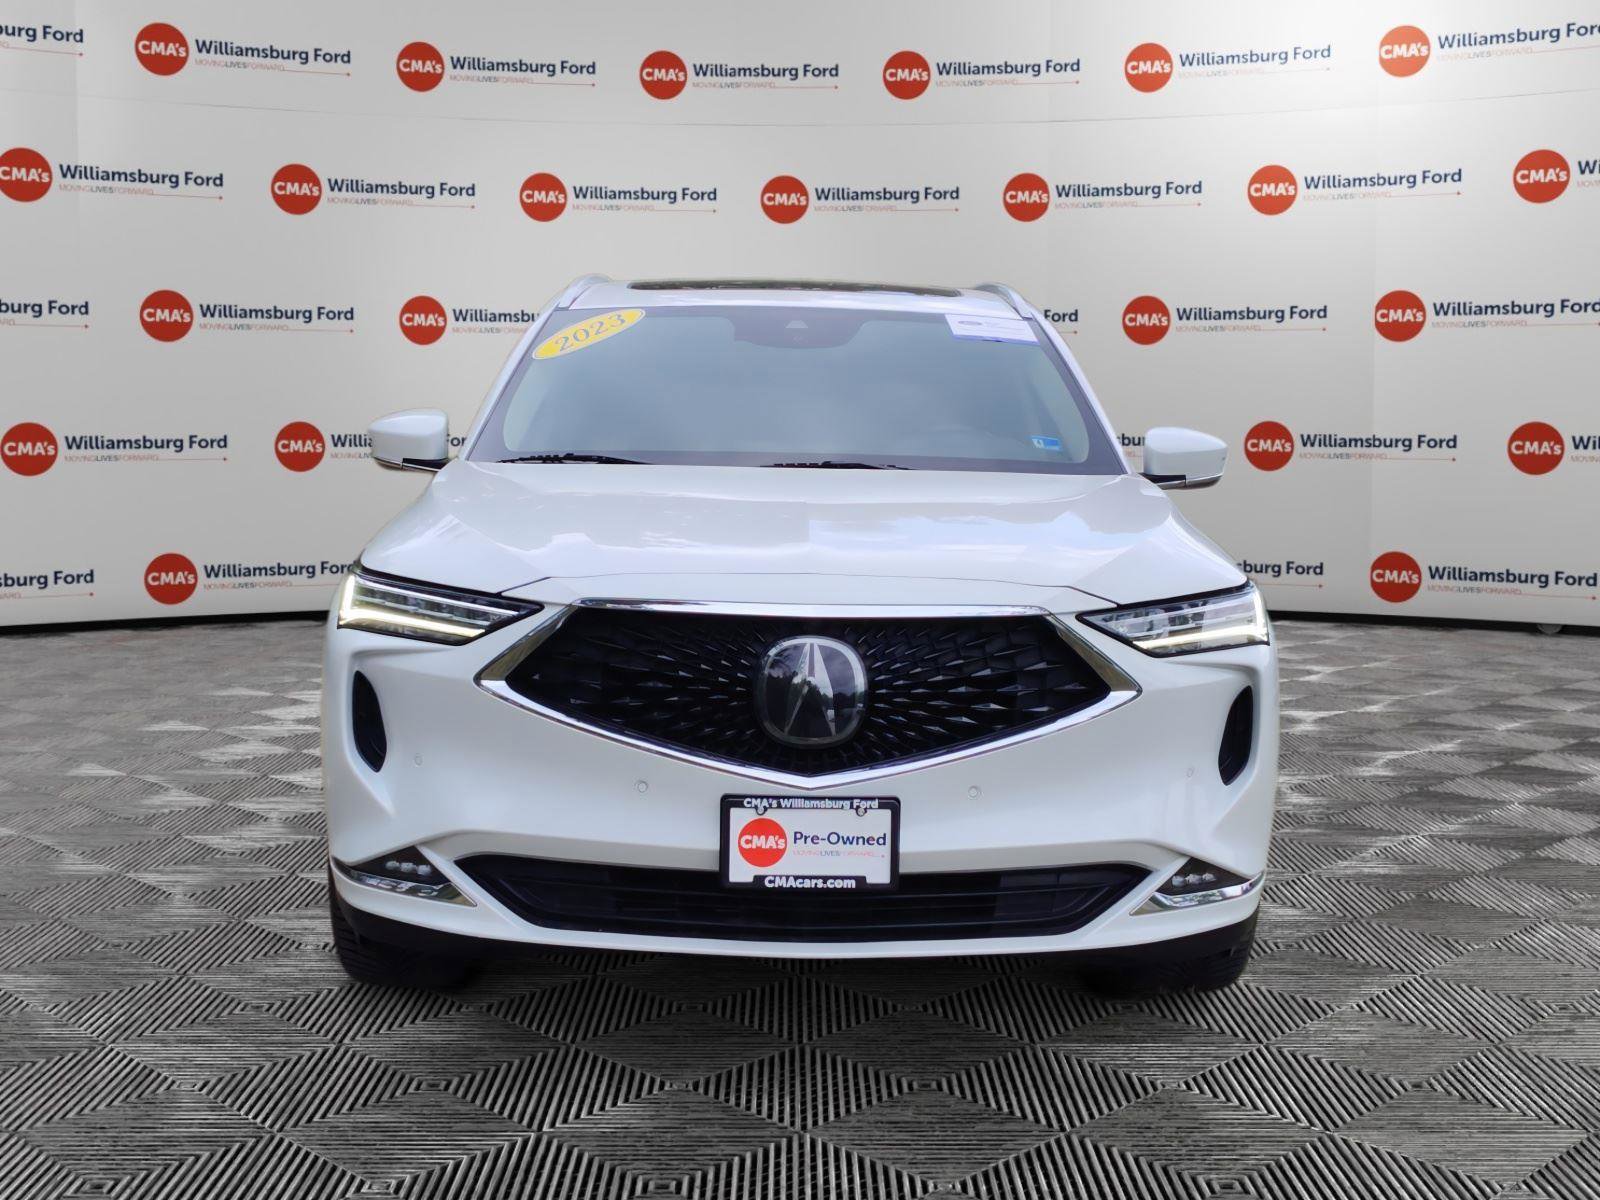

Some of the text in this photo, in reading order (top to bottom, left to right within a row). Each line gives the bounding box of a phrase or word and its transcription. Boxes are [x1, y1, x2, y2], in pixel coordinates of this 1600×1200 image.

[43, 25, 83, 43] Ford
[1380, 42, 1428, 59] CMA's
[1438, 28, 1560, 49] Williamsburg
[138, 39, 351, 65] CMA's Williamsburg Ford
[1127, 60, 1171, 74] CMA's
[1179, 50, 1288, 67] Williamsburg
[1293, 44, 1331, 60] Ford
[399, 56, 595, 77] CMA's Williamsburg Ford
[642, 64, 838, 82] CMA's Williamsburg Ford
[885, 59, 1080, 82] CMA's Williamsburg Ford
[0, 164, 223, 189] CMA's Williamsburg Ford
[1250, 168, 1462, 197] CMA's Williamsburg Ford
[1516, 168, 1567, 184] CMA's
[274, 178, 476, 199] CMA's Williamsburg Ford
[522, 186, 717, 204] CMA's Williamsburg Ford
[763, 187, 960, 206] CMA's Williamsburg Ford
[1005, 181, 1202, 203] CMA's Williamsburg Ford
[48, 300, 89, 315] Ford
[143, 304, 354, 324] CMA's Williamsburg Ford
[1125, 305, 1327, 326] CMA's Williamsburg Ford
[1377, 308, 1423, 323] CMA's
[1433, 300, 1555, 318] Williamsburg
[402, 312, 445, 327] CMA's
[554, 313, 626, 351] 2023
[3, 435, 228, 456] CMA's Williamsburg Ford
[278, 440, 322, 454] CMA's
[1247, 434, 1458, 453] CMA's Williamsburg Ford
[1511, 441, 1561, 456] CMA's
[54, 569, 95, 585] Ford
[147, 571, 195, 586] CMA's
[204, 562, 316, 579] Williamsburg
[1286, 561, 1324, 576] Ford
[1373, 565, 1598, 588] CMA's Williamsburg Ford
[743, 798, 879, 809] CMA's Williamsburg Ford
[740, 831, 887, 850] CMA's Pre-Owned
[764, 876, 856, 888] CMAcars.com
